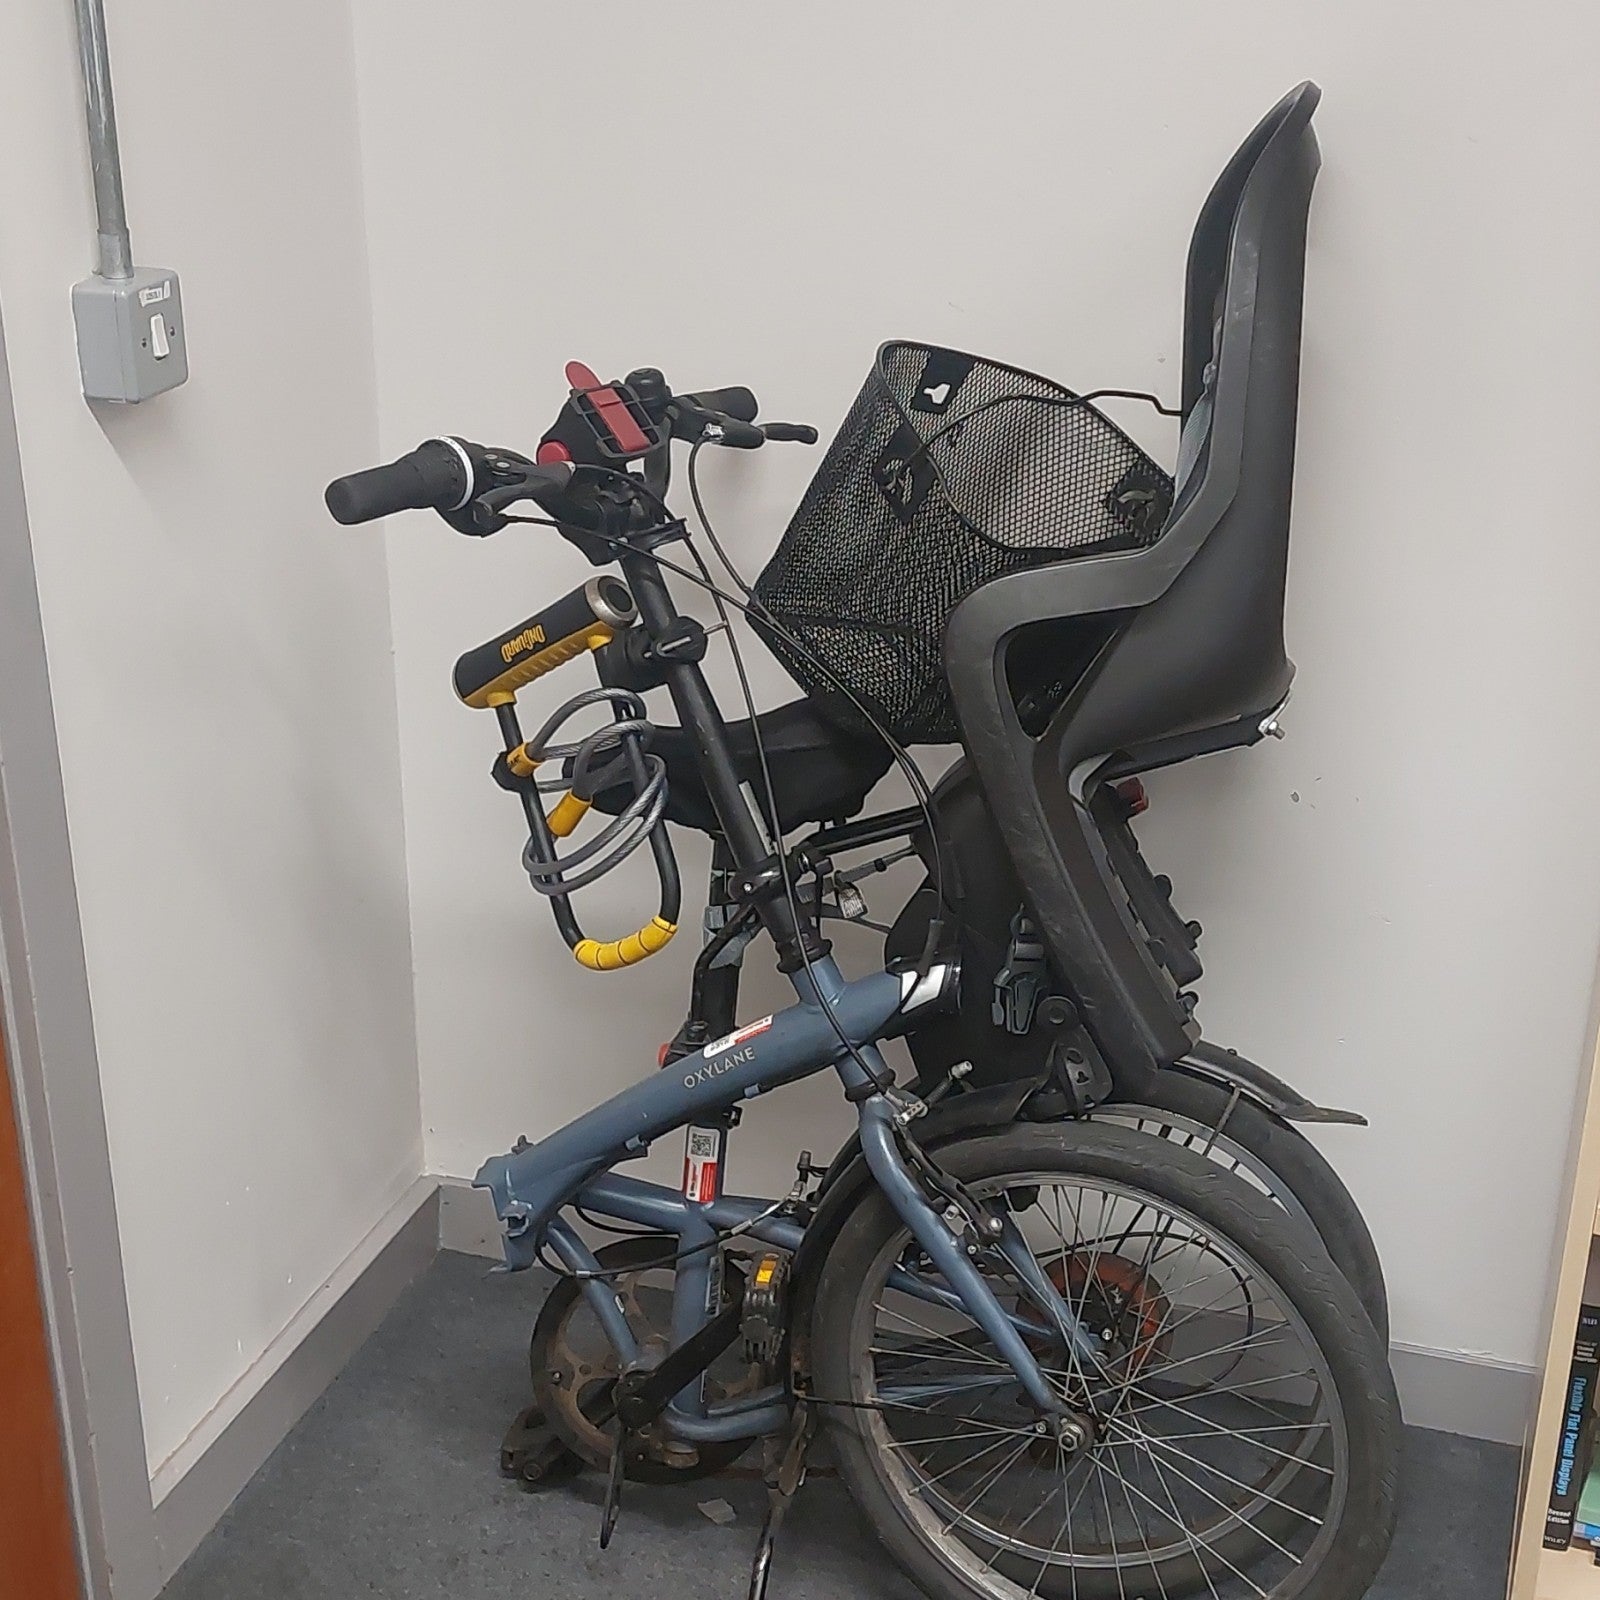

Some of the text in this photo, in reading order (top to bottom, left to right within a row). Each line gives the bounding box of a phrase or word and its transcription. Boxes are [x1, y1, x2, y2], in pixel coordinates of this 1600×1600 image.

[684, 1047, 755, 1089] OXYLANE
[1571, 1377, 1587, 1412] Flexible
[1567, 1413, 1581, 1430] Flat
[1563, 1432, 1579, 1457] Panel
[1556, 1458, 1573, 1496] Displays
[1544, 1535, 1566, 1545] WILEY
